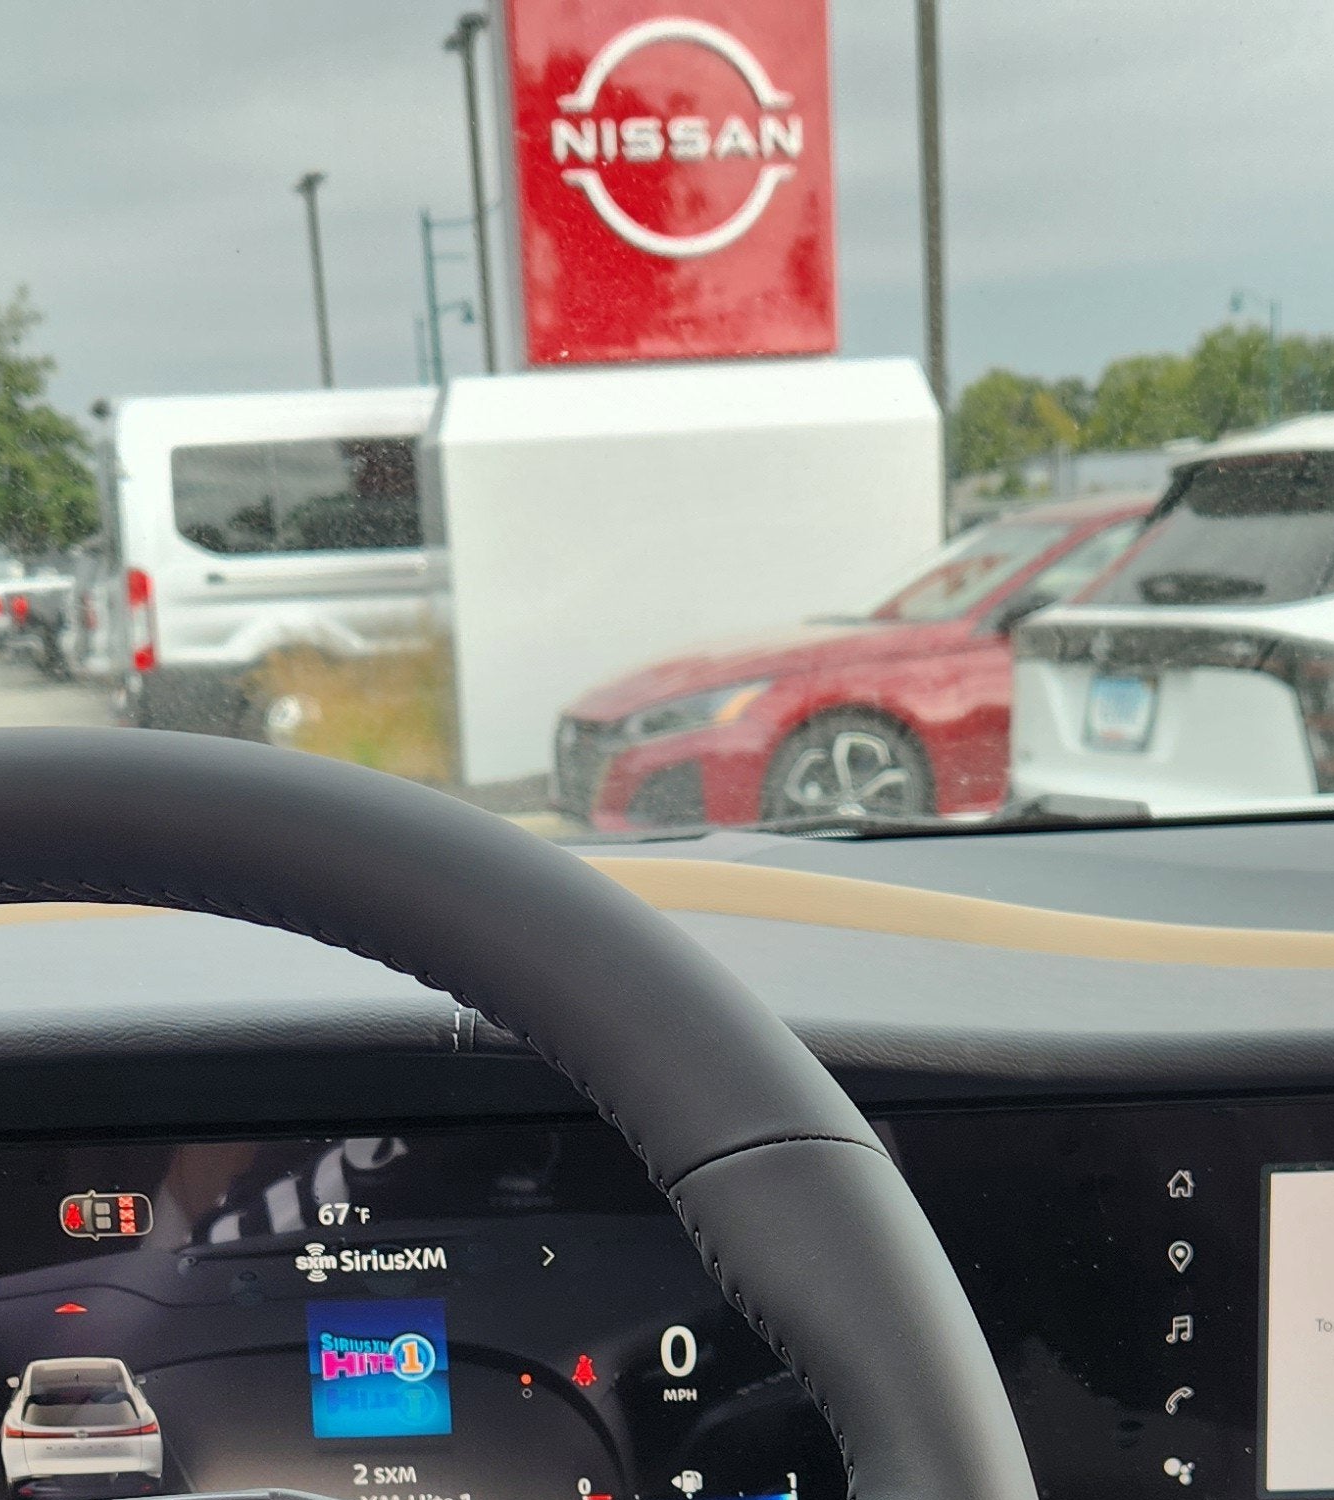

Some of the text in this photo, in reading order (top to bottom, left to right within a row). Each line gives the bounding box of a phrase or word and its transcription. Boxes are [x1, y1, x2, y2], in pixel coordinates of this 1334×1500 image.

[551, 115, 804, 164] NISSAN
[318, 1203, 350, 1226] 67
[339, 1247, 448, 1273] SiriusXM
[1315, 1317, 1333, 1333] To
[399, 1340, 424, 1374] 1
[660, 1325, 697, 1378] 0
[663, 1388, 698, 1402] MPH
[353, 1463, 369, 1486] 2
[578, 1477, 591, 1495] 0
[786, 1472, 798, 1489] 1
